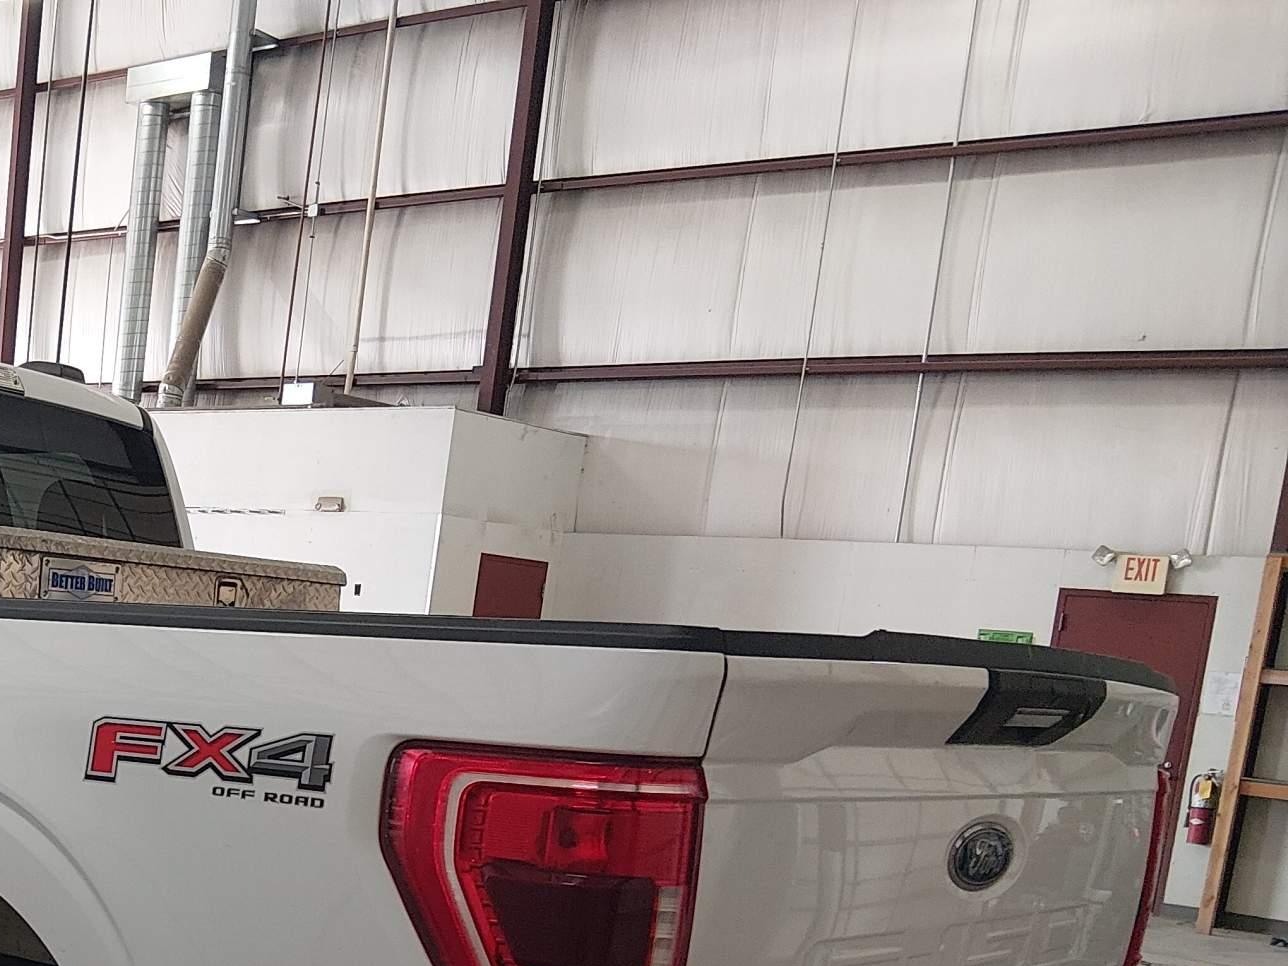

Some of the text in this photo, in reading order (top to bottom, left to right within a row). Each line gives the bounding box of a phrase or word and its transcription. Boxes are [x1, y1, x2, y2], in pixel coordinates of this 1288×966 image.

[51, 570, 113, 593] BETTER BUILT
[1123, 556, 1161, 582] EXIT
[83, 716, 335, 793] FX4
[211, 785, 325, 809] OFF ROAD
